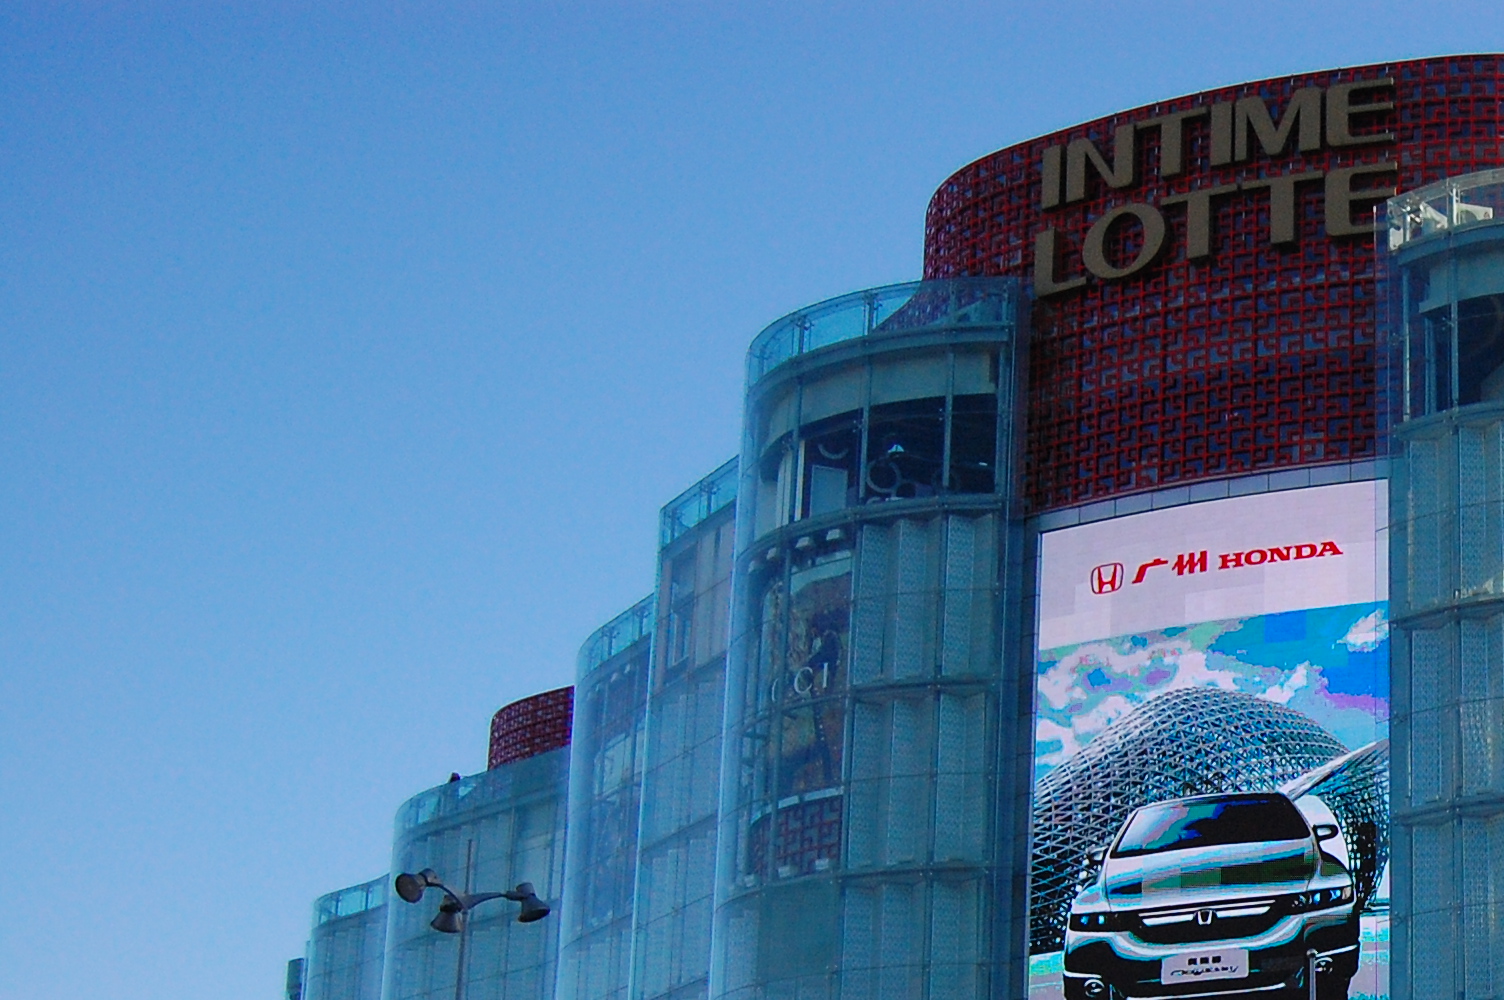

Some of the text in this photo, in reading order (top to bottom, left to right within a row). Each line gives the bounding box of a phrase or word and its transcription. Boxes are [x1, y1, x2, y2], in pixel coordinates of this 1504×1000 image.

[1041, 77, 1395, 209] INTIME
[1033, 161, 1398, 298] LOTTE
[1131, 540, 1344, 584] 广州 HONDA
